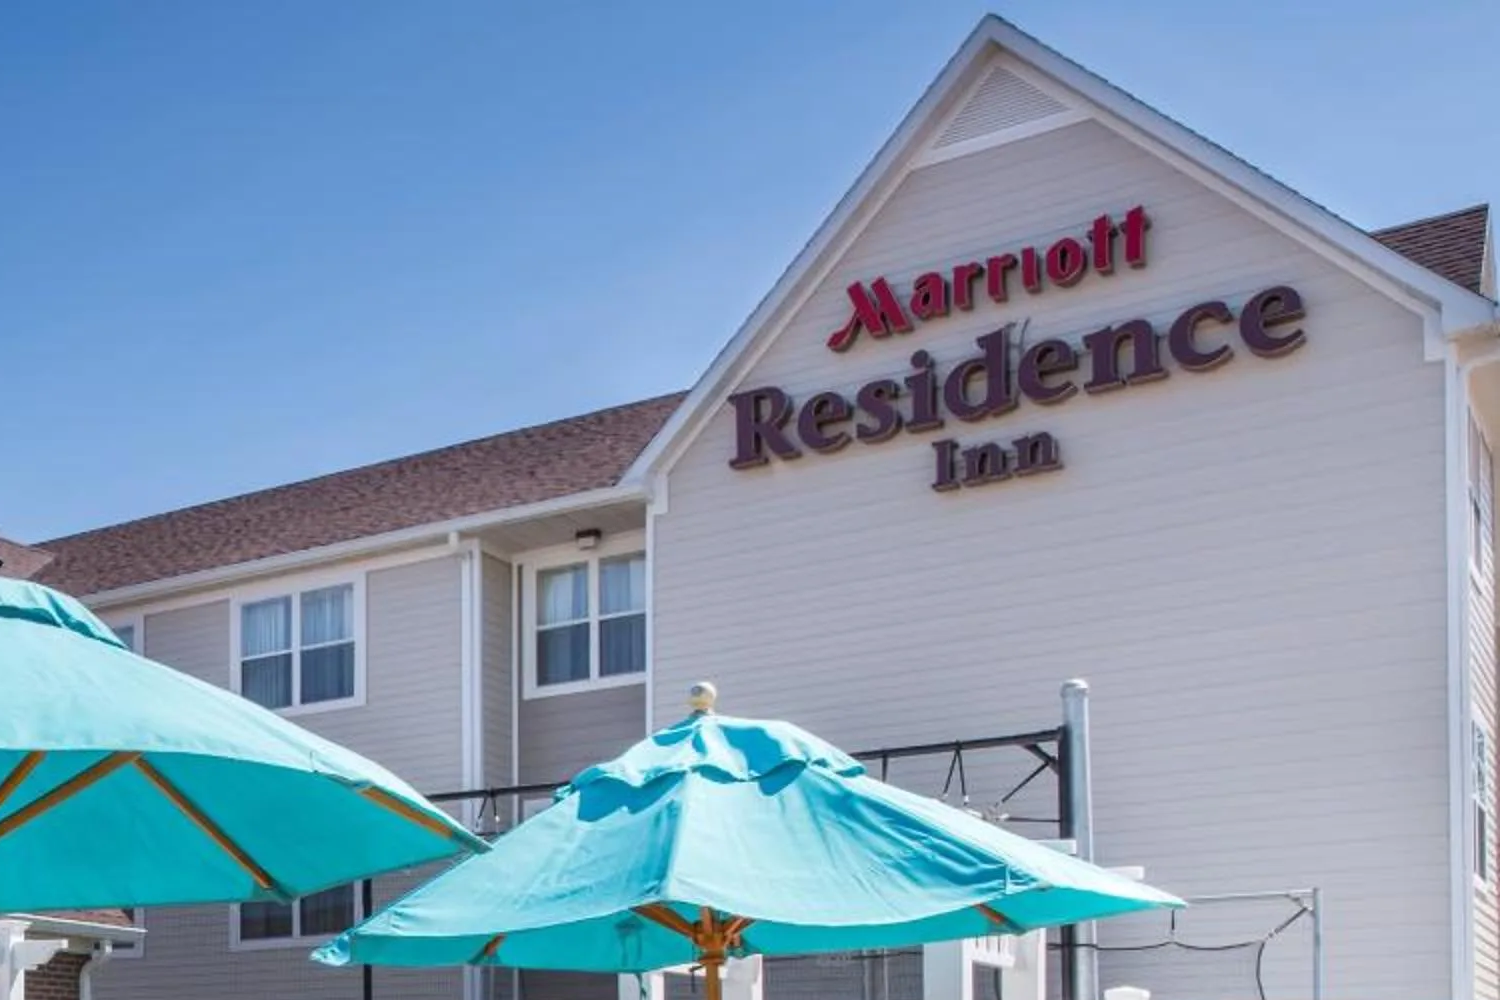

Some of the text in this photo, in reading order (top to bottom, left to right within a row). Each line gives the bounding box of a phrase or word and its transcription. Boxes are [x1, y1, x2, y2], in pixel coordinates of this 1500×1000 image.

[826, 205, 1150, 352] Marriott
[727, 284, 1307, 470] Residence
[931, 430, 1064, 491] Inn
